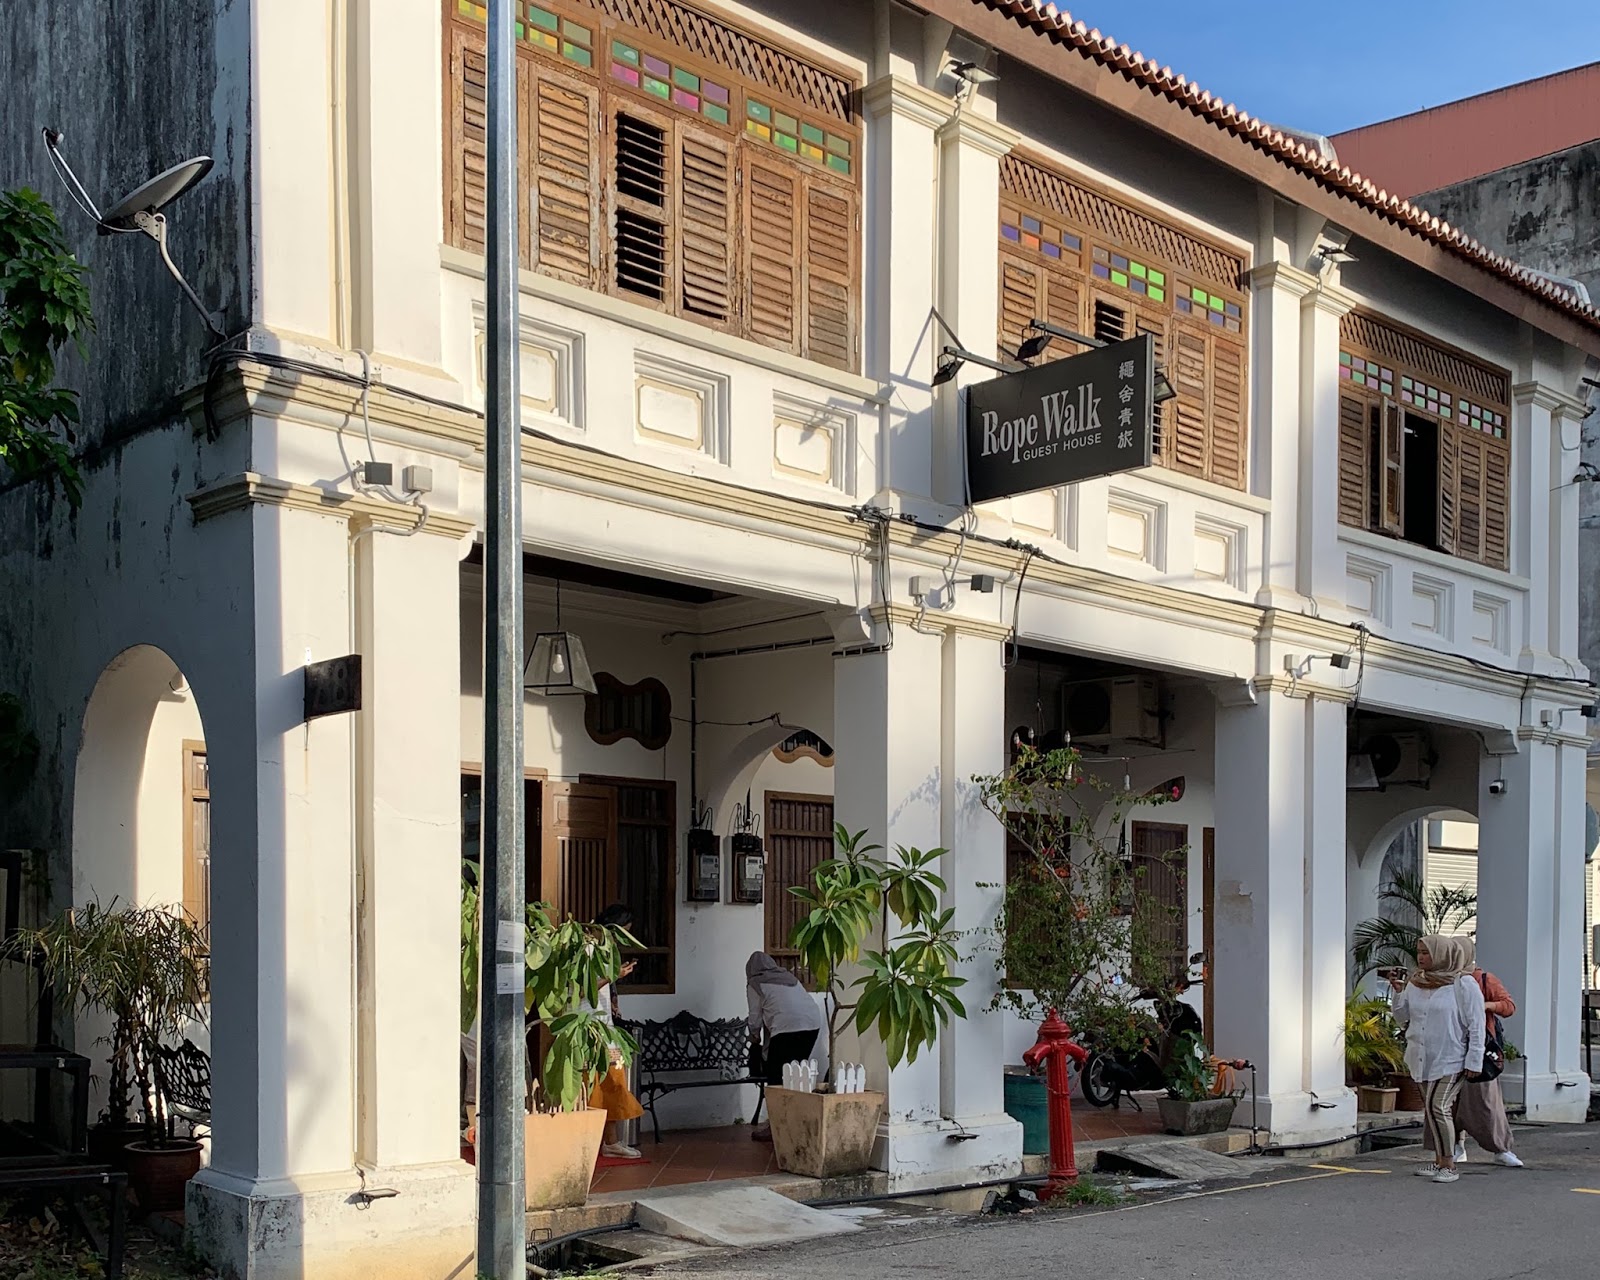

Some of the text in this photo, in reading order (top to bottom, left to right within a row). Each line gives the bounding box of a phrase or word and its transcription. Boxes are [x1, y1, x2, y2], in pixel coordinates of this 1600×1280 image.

[981, 382, 1102, 464] Rope Walk
[1023, 432, 1102, 461] GUEST HOUSE
